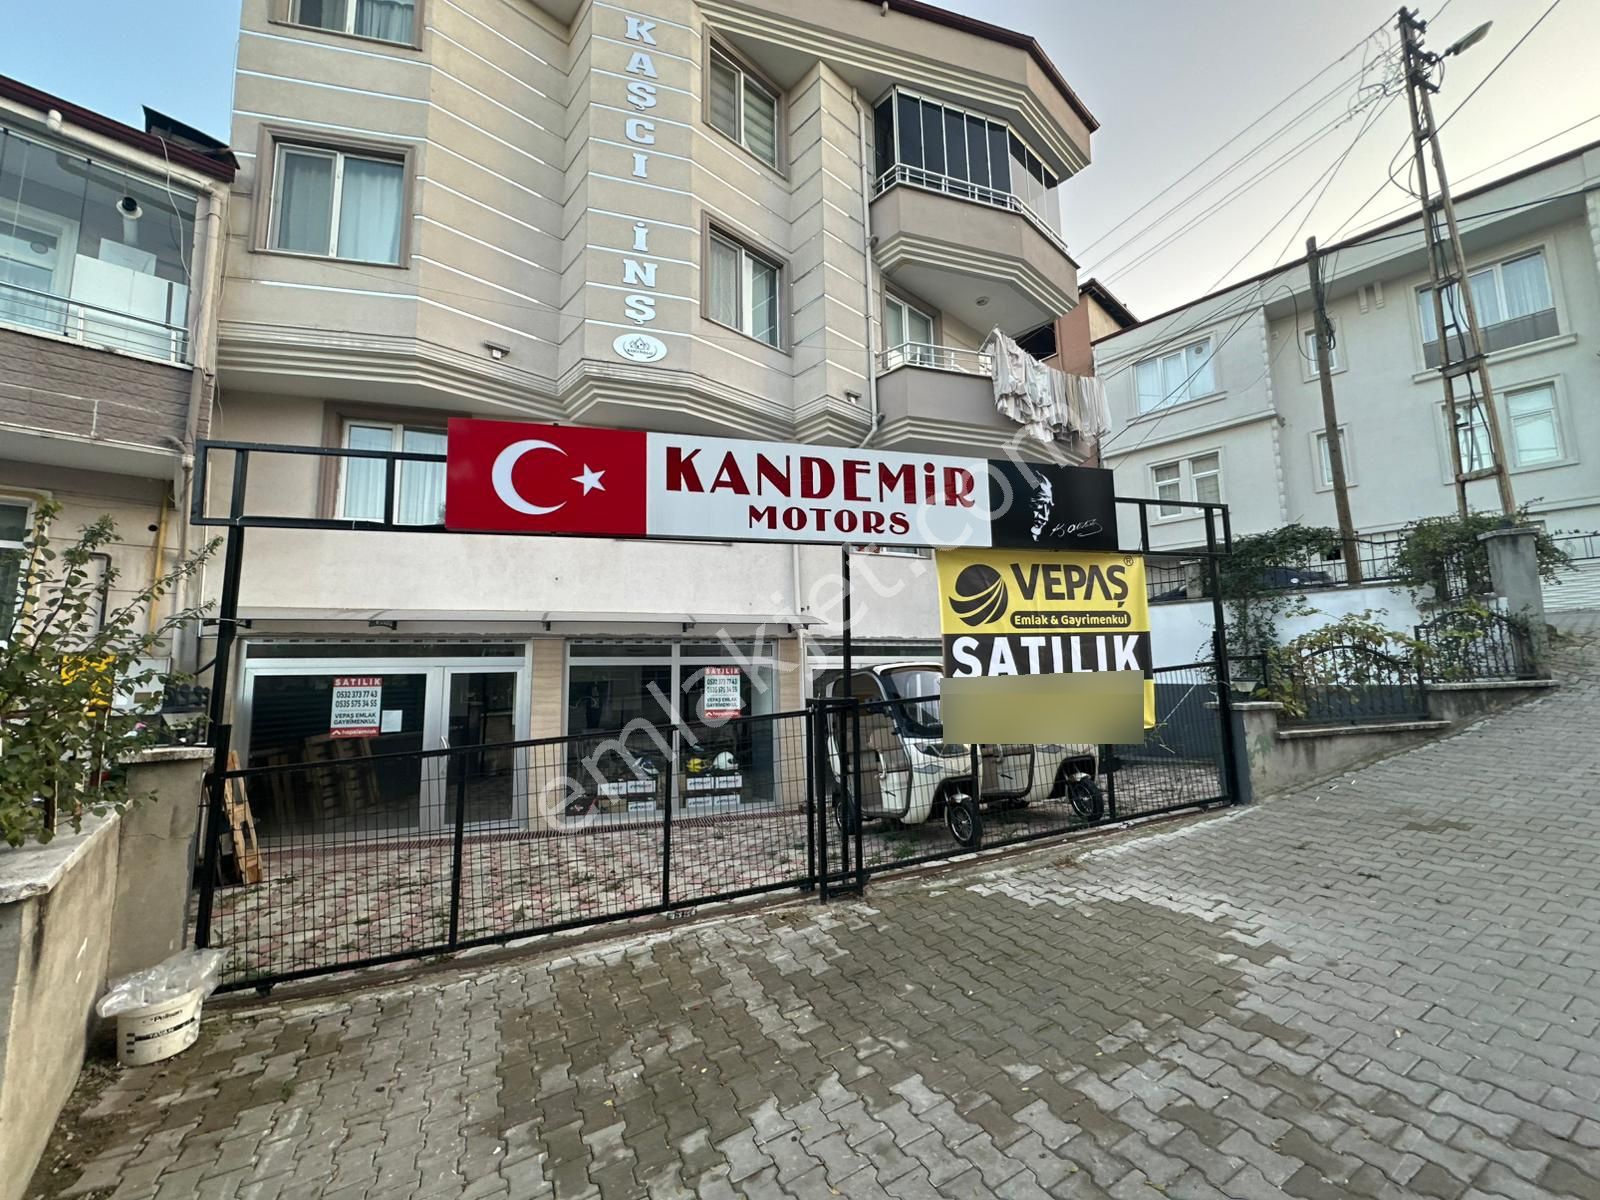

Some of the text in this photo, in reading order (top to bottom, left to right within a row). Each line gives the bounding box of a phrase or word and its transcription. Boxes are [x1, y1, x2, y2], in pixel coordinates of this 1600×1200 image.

[748, 504, 910, 535] MOTORS
[1009, 562, 1129, 608] VEPAŞ
[1014, 613, 1128, 628] Emlak & Gayrimenkul
[951, 634, 1141, 678] SATILIK
